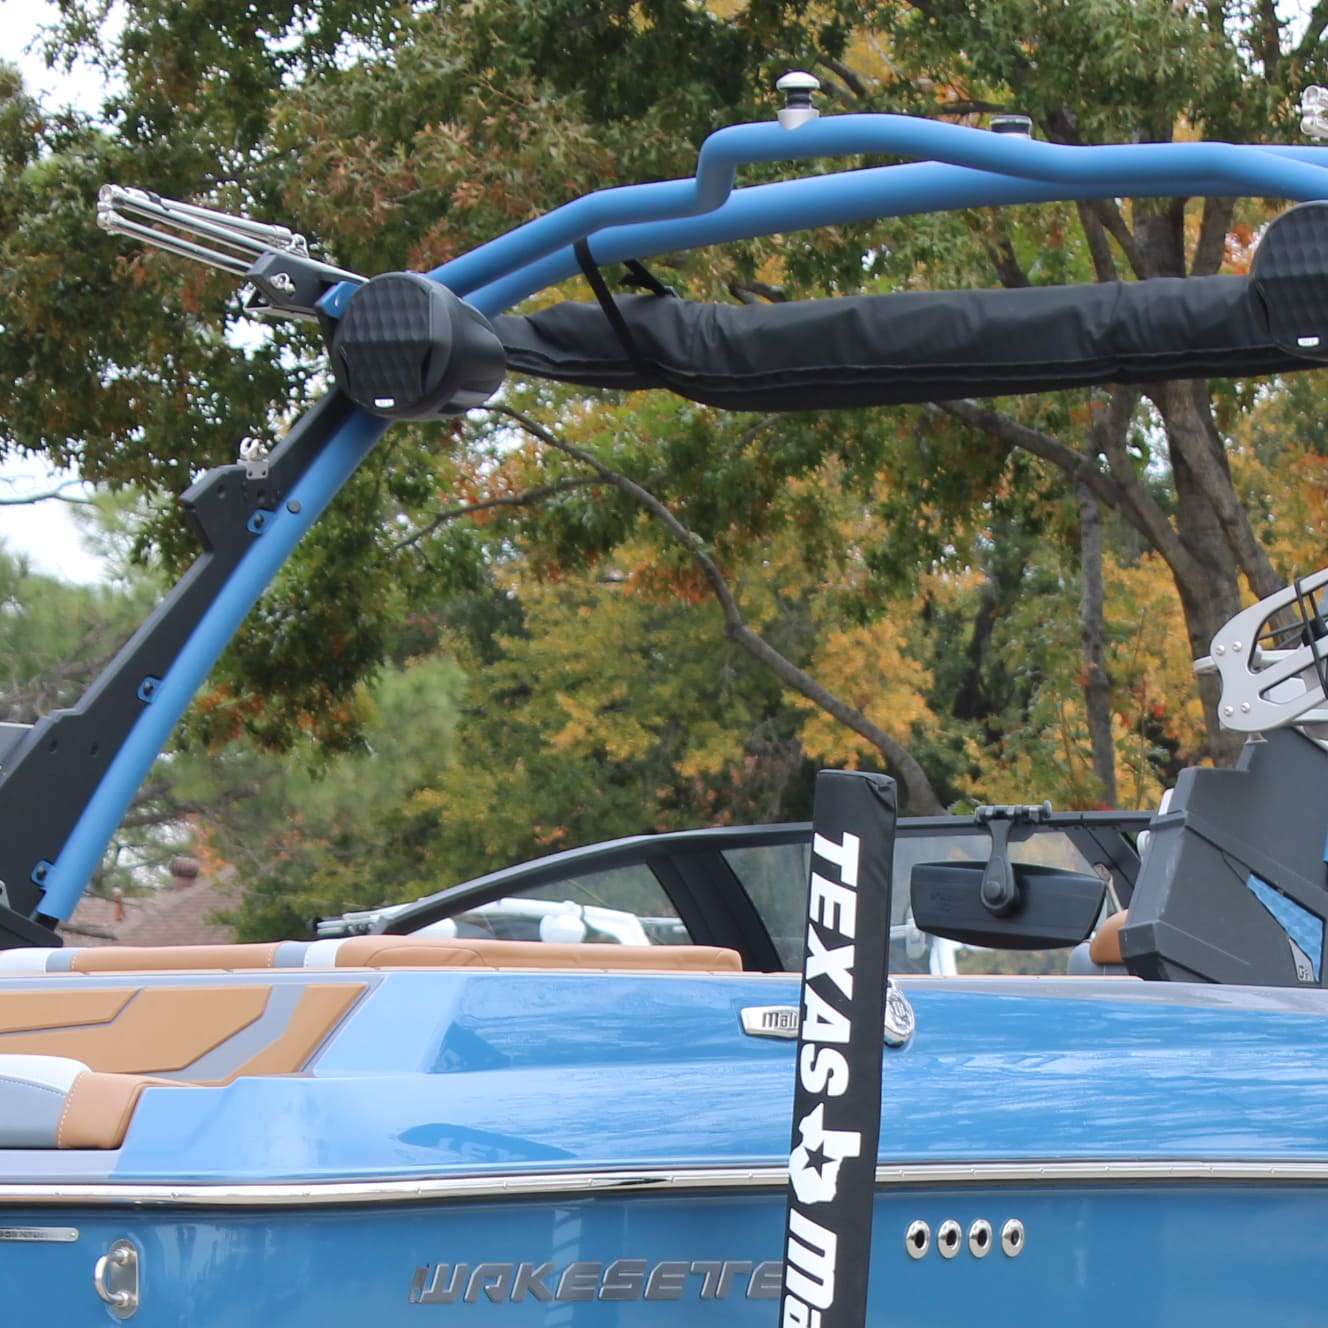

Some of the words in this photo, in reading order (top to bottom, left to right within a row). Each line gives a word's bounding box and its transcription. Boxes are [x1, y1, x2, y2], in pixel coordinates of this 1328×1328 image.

[800, 831, 860, 1097] TEXAS
[761, 1010, 800, 1029] Mali
[408, 1259, 784, 1304] WAKESETTE
